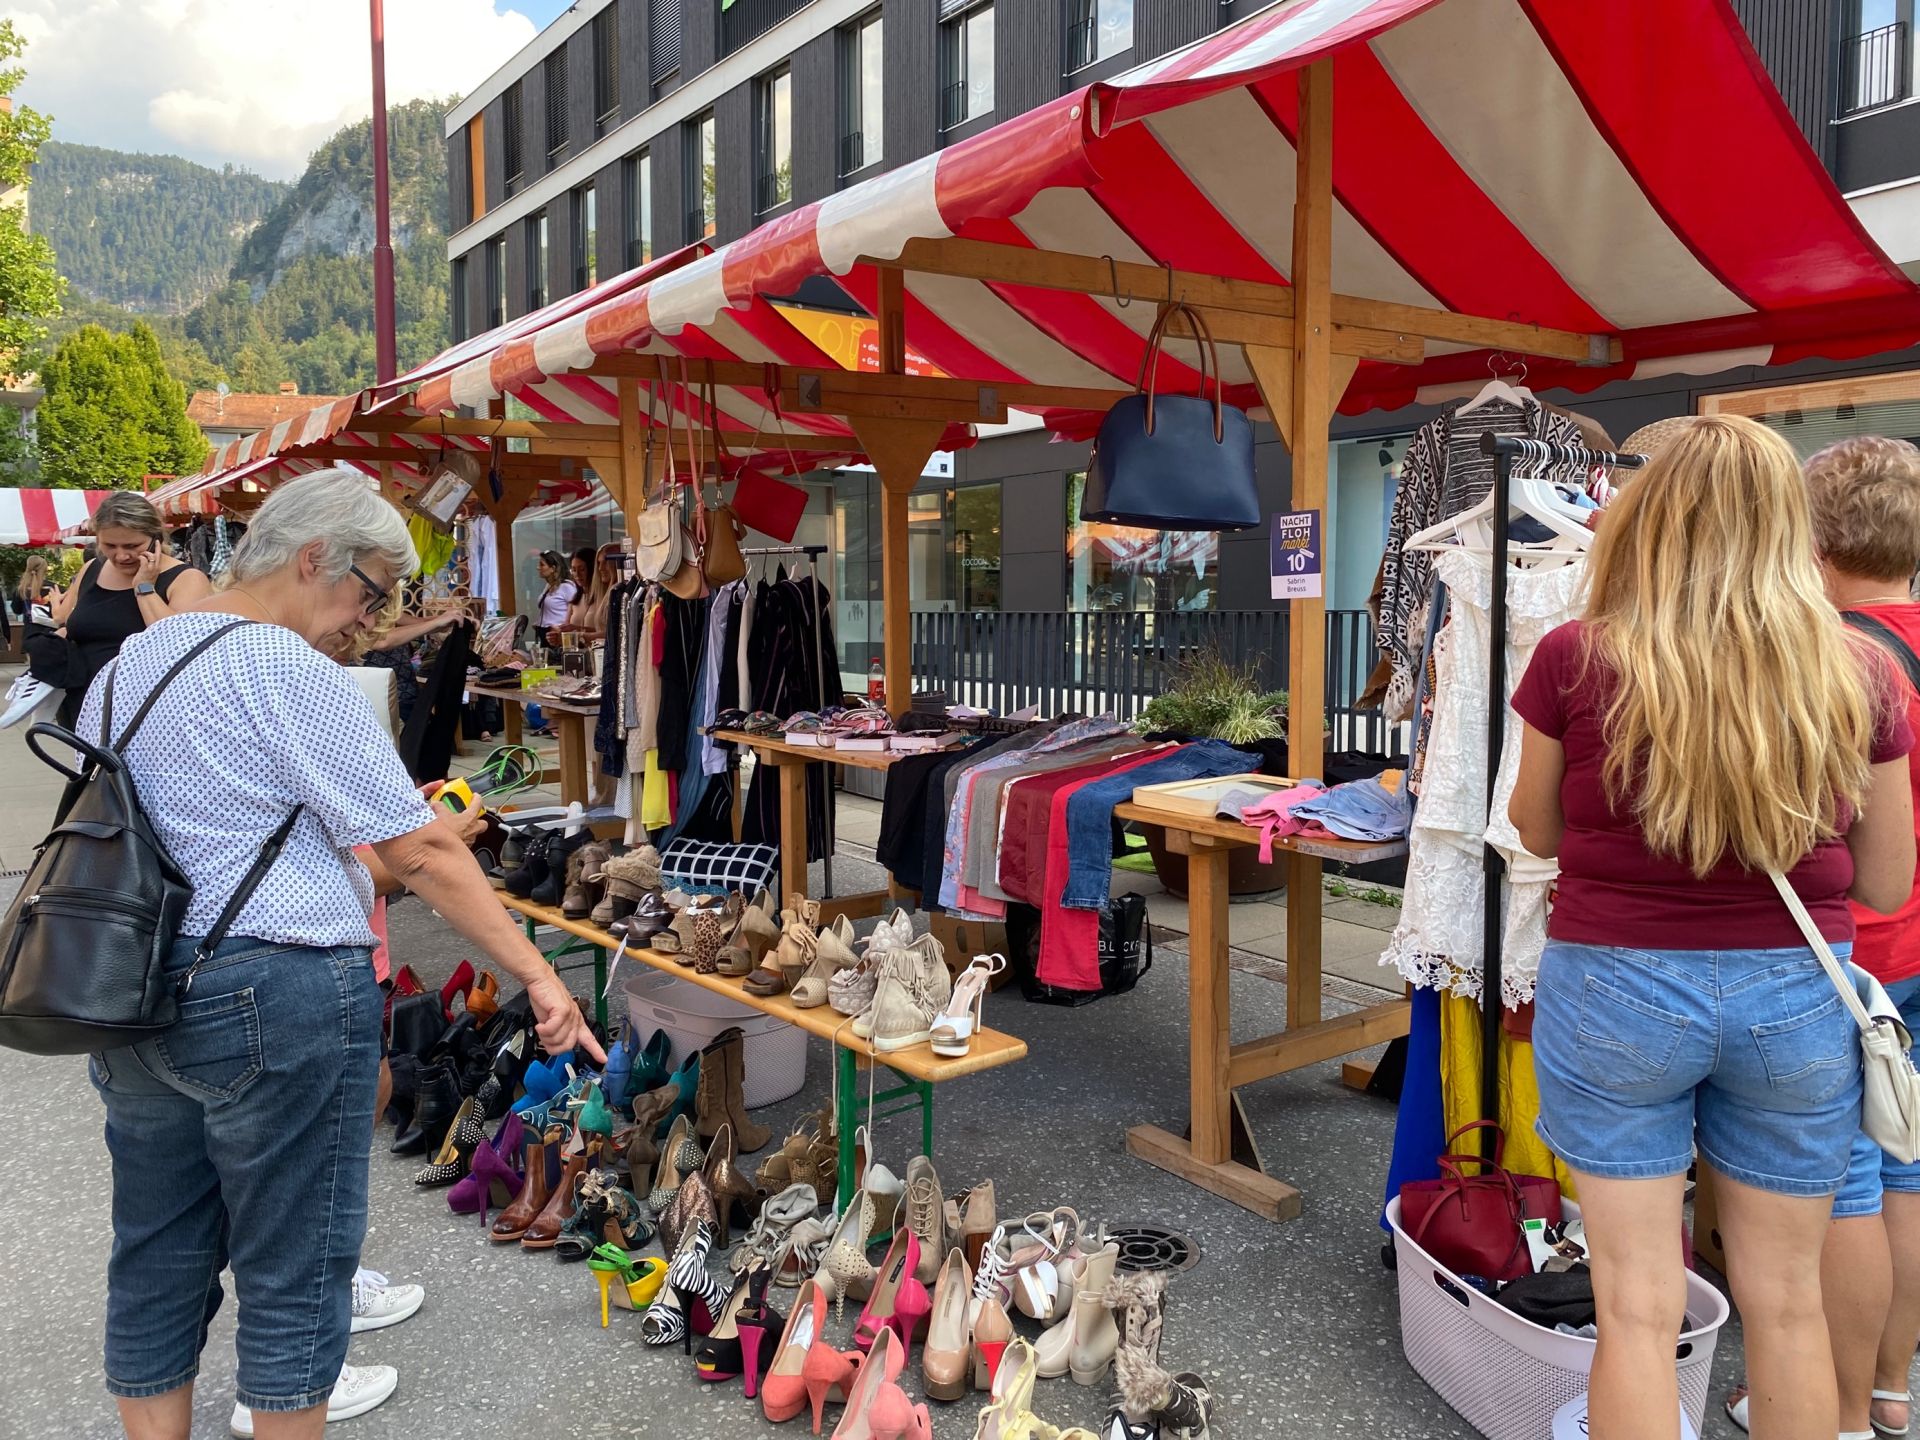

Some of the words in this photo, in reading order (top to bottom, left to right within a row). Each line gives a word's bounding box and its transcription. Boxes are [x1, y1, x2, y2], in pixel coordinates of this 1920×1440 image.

[1281, 516, 1310, 527] NACHT
[1281, 528, 1310, 539] FLOH
[1287, 553, 1305, 572] 10
